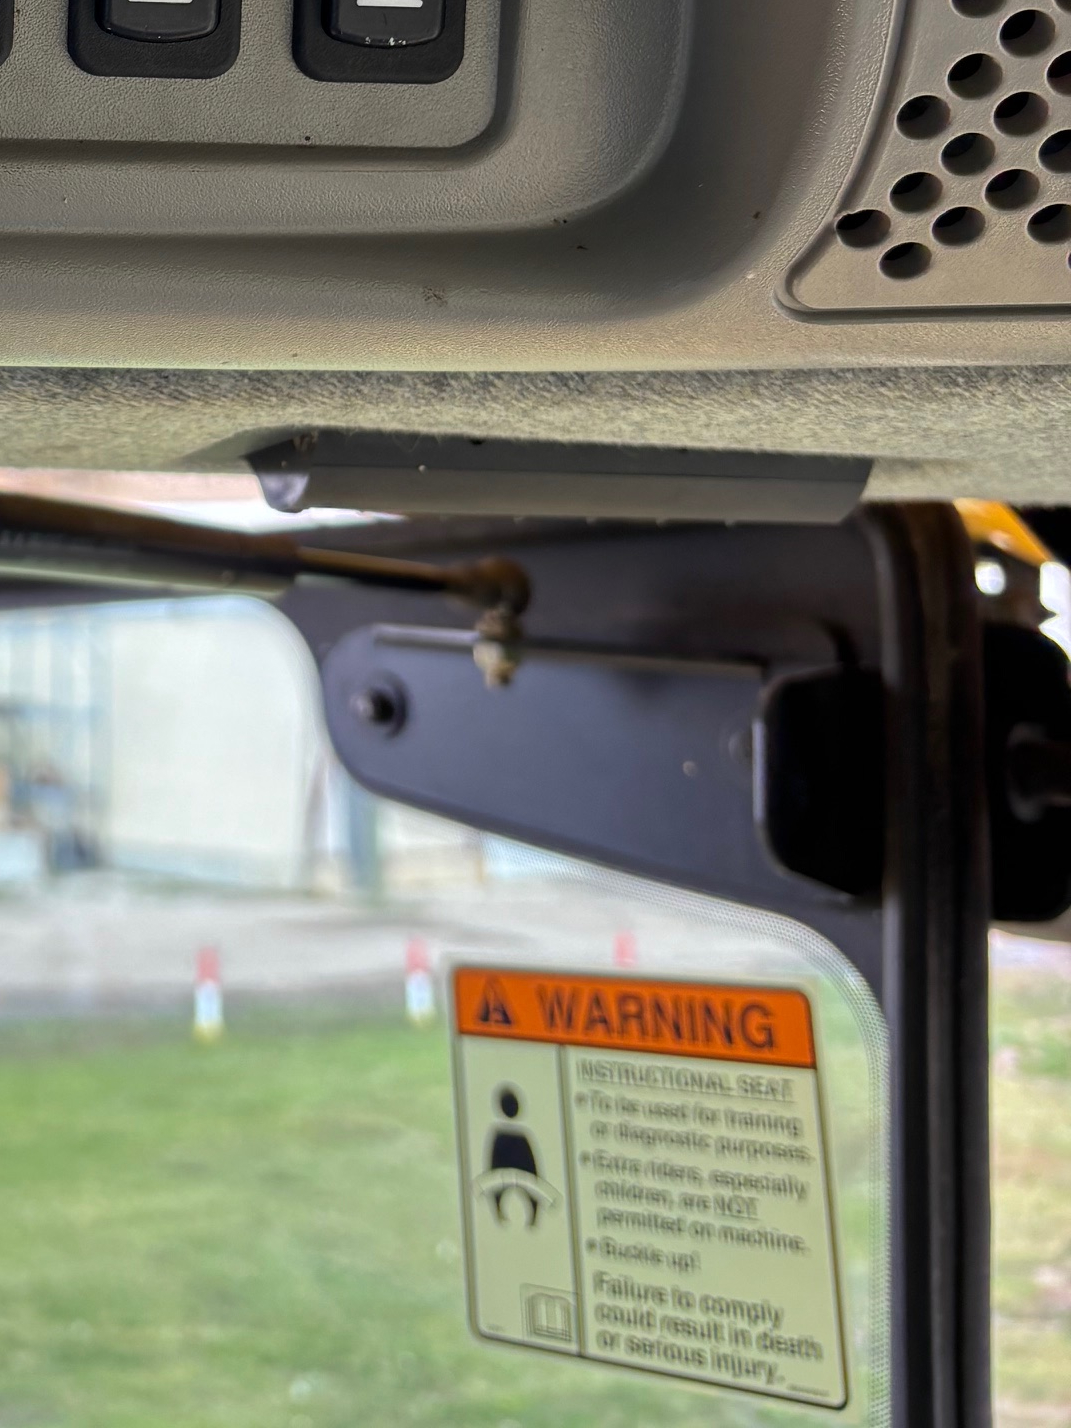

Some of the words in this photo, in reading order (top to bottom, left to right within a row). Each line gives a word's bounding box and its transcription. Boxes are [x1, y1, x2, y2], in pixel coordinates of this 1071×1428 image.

[538, 983, 774, 1049] WARNING
[577, 1058, 733, 1094] INSTRUCTIONAL
[735, 1073, 794, 1100] SEAT
[614, 1121, 712, 1152] diagnostic
[692, 1101, 721, 1124] for
[724, 1107, 805, 1139] training
[708, 1170, 810, 1202] especially
[712, 1192, 760, 1217] NOT
[596, 1207, 687, 1236] permitted
[687, 1220, 716, 1240] on
[593, 1269, 669, 1306] Failure
[671, 1285, 696, 1310] to
[699, 1293, 785, 1330] comply
[594, 1302, 657, 1329] could
[659, 1313, 727, 1343] result
[728, 1322, 753, 1347] in
[755, 1330, 823, 1362] death
[595, 1329, 622, 1351] or
[624, 1334, 709, 1366] serious
